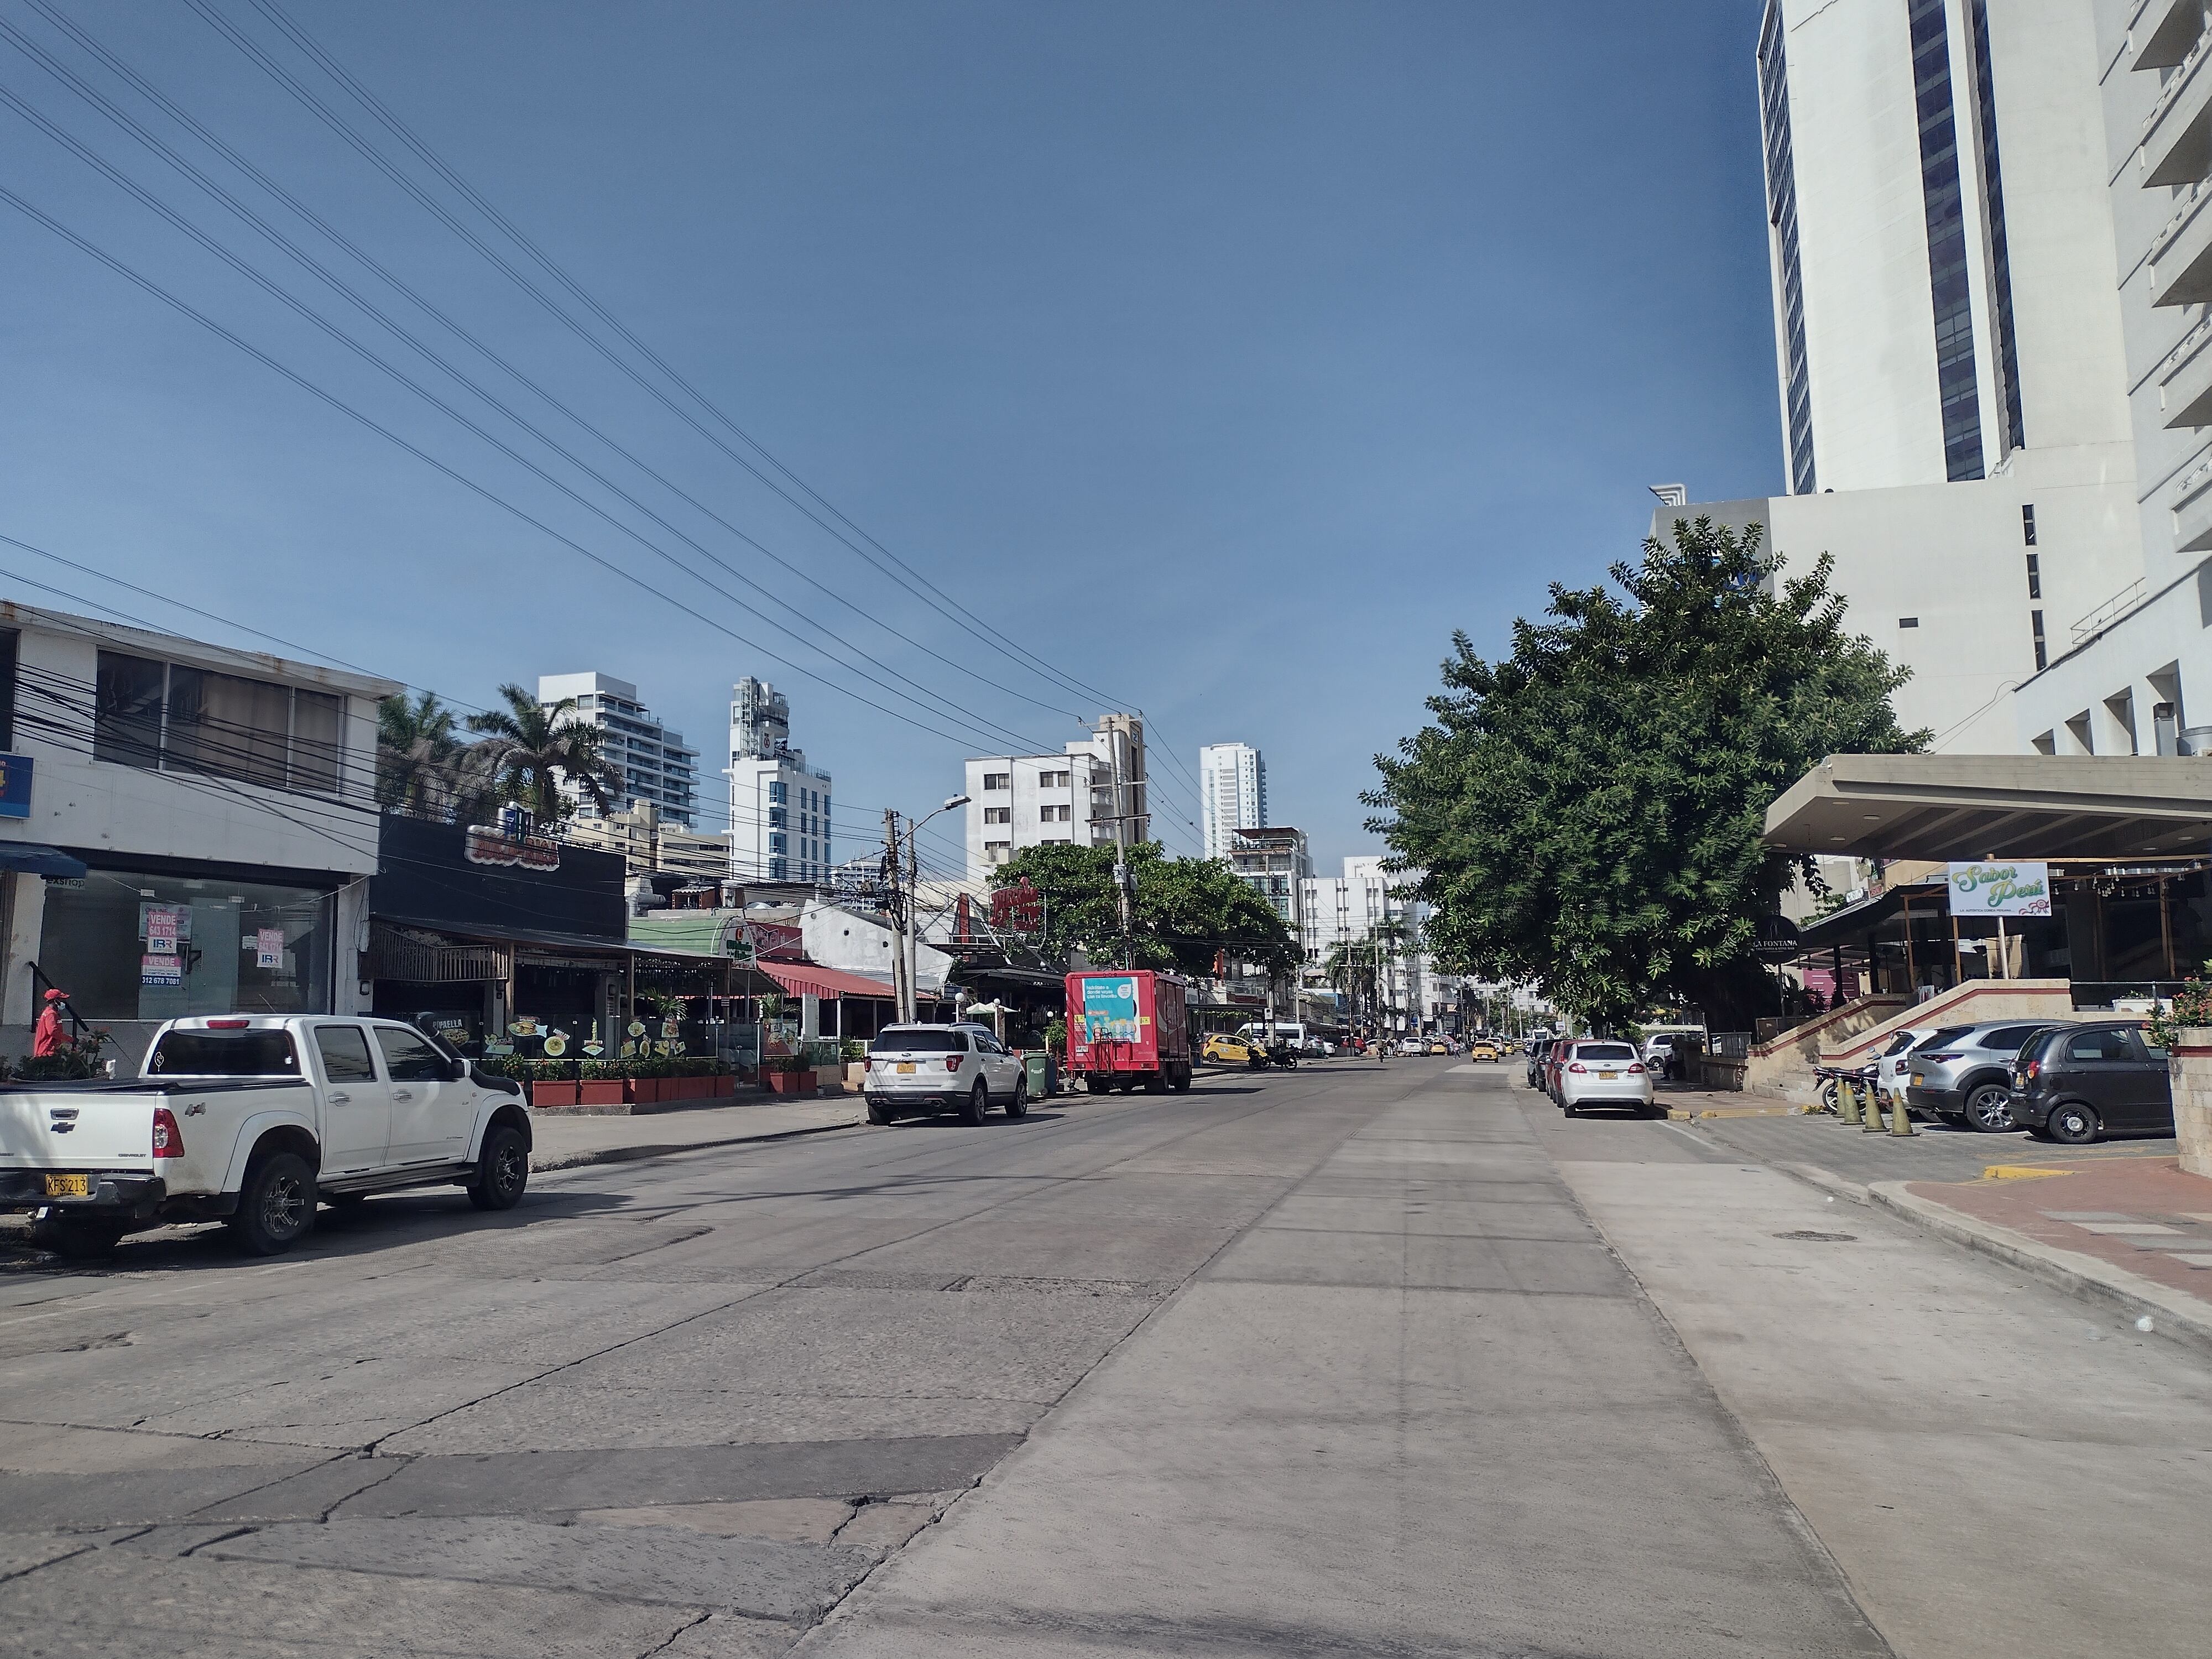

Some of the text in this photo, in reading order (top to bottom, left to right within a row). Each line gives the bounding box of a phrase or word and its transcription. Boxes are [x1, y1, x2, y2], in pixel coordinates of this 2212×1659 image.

[1952, 865, 2018, 892] Sabor
[1987, 878, 2044, 907] Perú
[151, 914, 176, 925] VENDE
[149, 925, 176, 936] 643 1714
[260, 931, 283, 942] VENDE
[149, 957, 175, 966] VENDE
